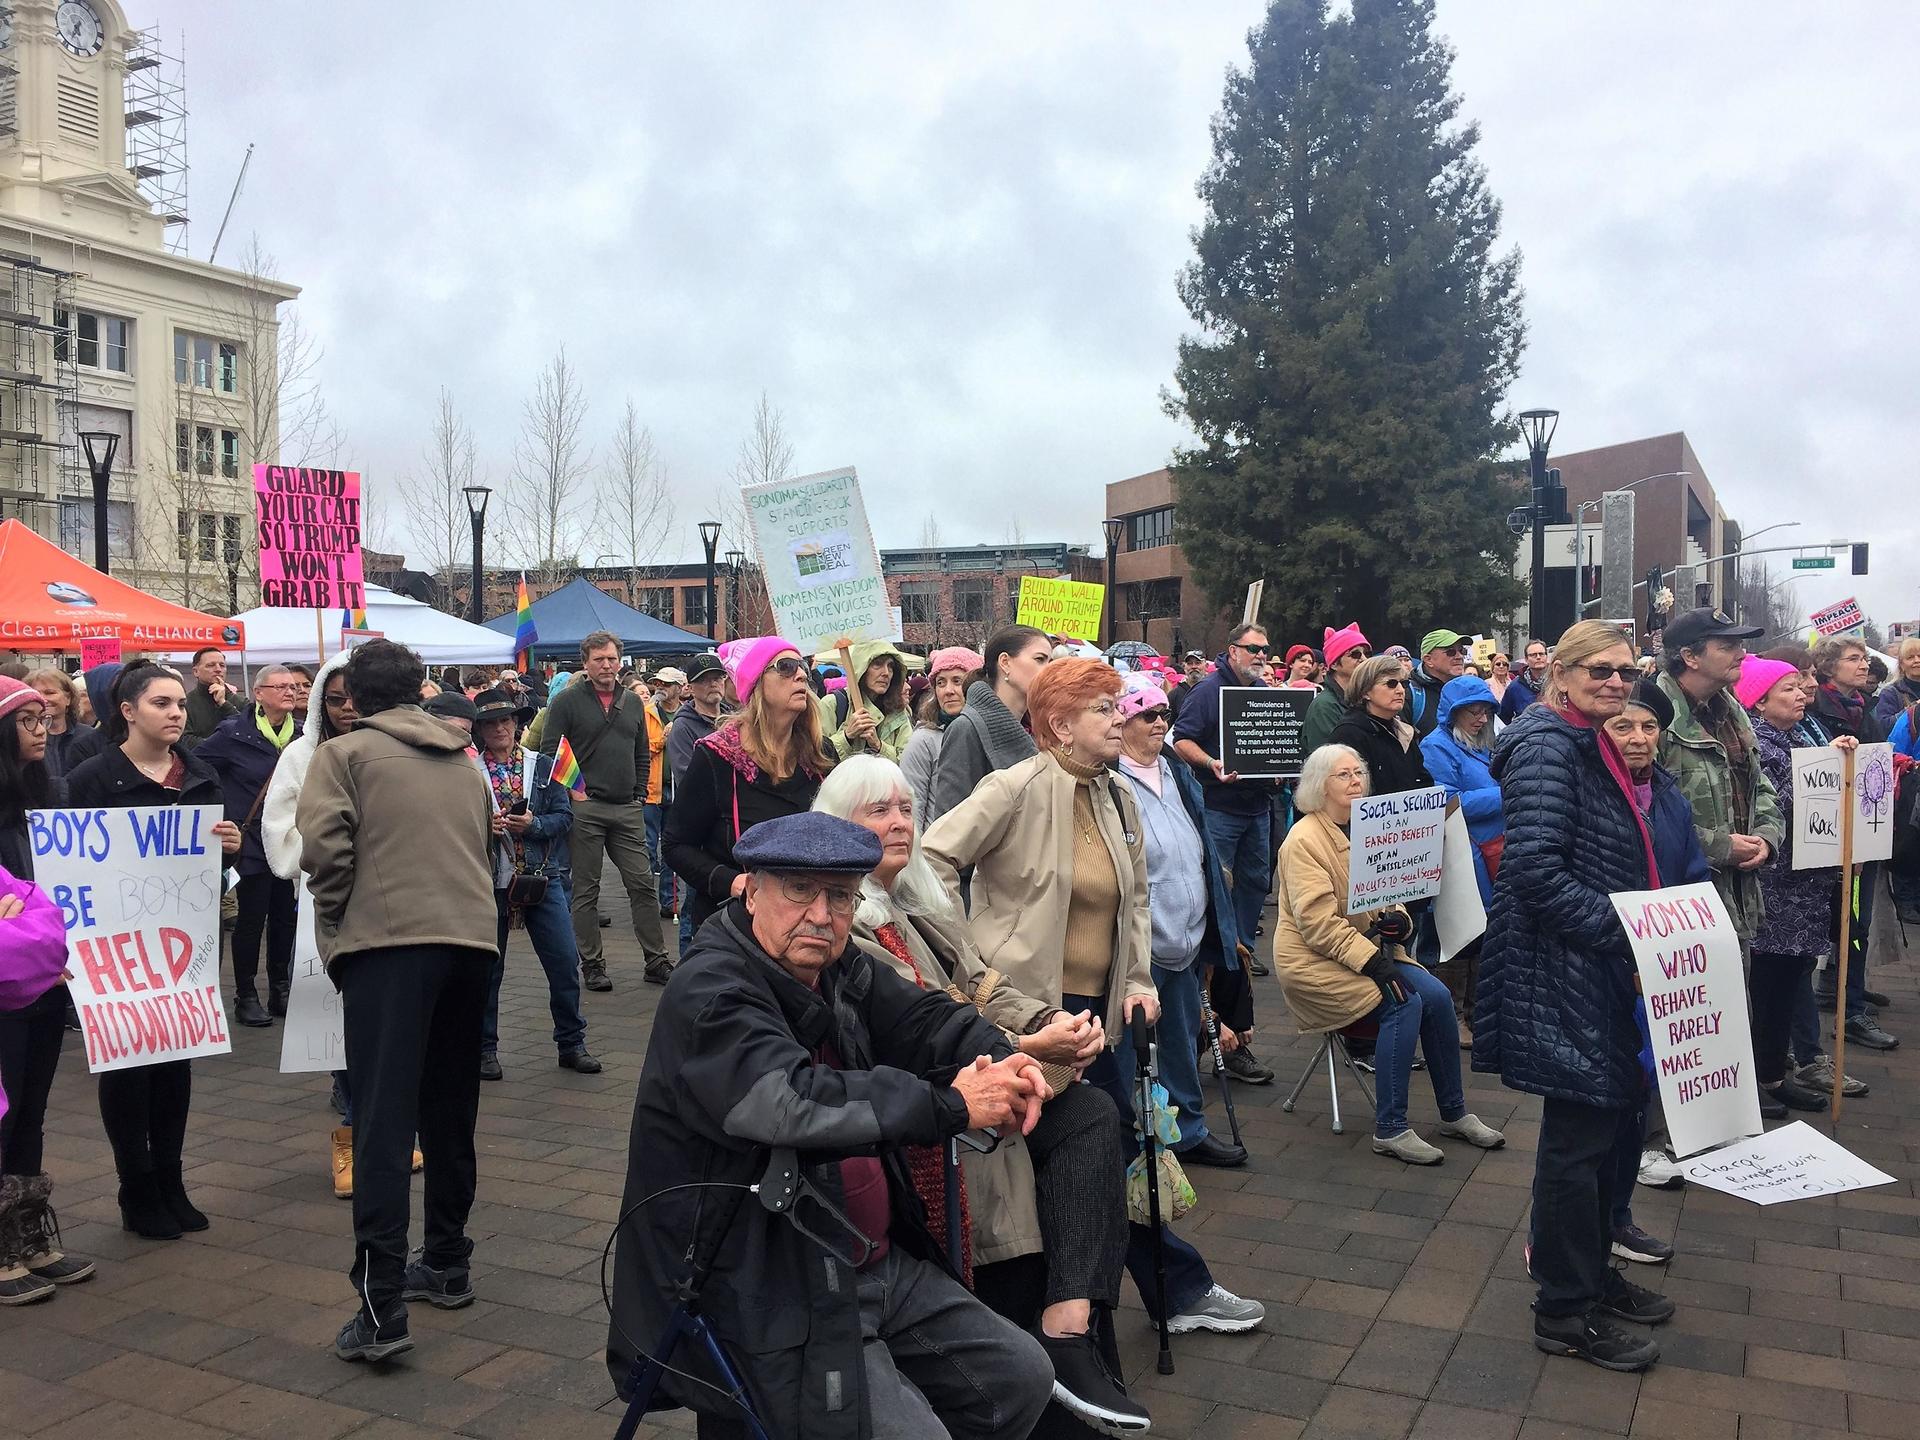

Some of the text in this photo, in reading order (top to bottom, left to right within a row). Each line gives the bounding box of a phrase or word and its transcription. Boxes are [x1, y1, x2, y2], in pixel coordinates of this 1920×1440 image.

[266, 465, 345, 497] GUARD
[257, 492, 360, 525] YOUR CAT
[751, 488, 798, 508] SONOMA
[260, 521, 360, 553] SO TRUMP
[788, 515, 848, 537] SUPPORTS
[280, 552, 345, 581] WON'T
[1796, 560, 1818, 568] Fourth
[263, 579, 360, 609] GRAB IT
[829, 577, 879, 597] WISDOM
[1023, 580, 1098, 600] BUILD A WALL
[791, 595, 877, 624] NATIVE VOICES
[1021, 597, 1100, 618] AROUND TRUMP
[1814, 603, 1857, 626] IMPEACH
[2, 621, 213, 640] Clean River ALLIANCE
[799, 627, 812, 640] IN
[814, 614, 873, 636] CONGRESS
[1043, 617, 1060, 632] PAY
[1062, 619, 1079, 633] FOR
[1083, 621, 1096, 634] IT
[1819, 613, 1861, 635] TRUMP
[1235, 729, 1263, 737] wounding
[1360, 790, 1447, 821] SOCIAL SECURITY
[30, 809, 206, 863] BOYS WILL
[1365, 824, 1437, 848] EARNED BENEFIT
[1395, 817, 1409, 829] AN
[1366, 849, 1398, 865] NOT AN
[1376, 851, 1431, 874] ENTITLEMENT
[1354, 883, 1364, 895] NO
[1389, 876, 1398, 886] TO
[53, 869, 214, 930] BE BOYS
[1366, 896, 1381, 906] your
[1620, 896, 1716, 940] WOMEN
[75, 927, 215, 995] HELD #metoo
[1657, 943, 1708, 980] WHO
[1651, 984, 1712, 1020] BEHAVE,
[81, 986, 226, 1065] ACCOUNTABLE
[1668, 1011, 1722, 1046] RARELY
[1212, 1038, 1225, 1071] RESIST
[1661, 1048, 1703, 1077] MAKE
[1678, 1062, 1740, 1105] HISTORY
[1690, 1153, 1766, 1178] Charge
